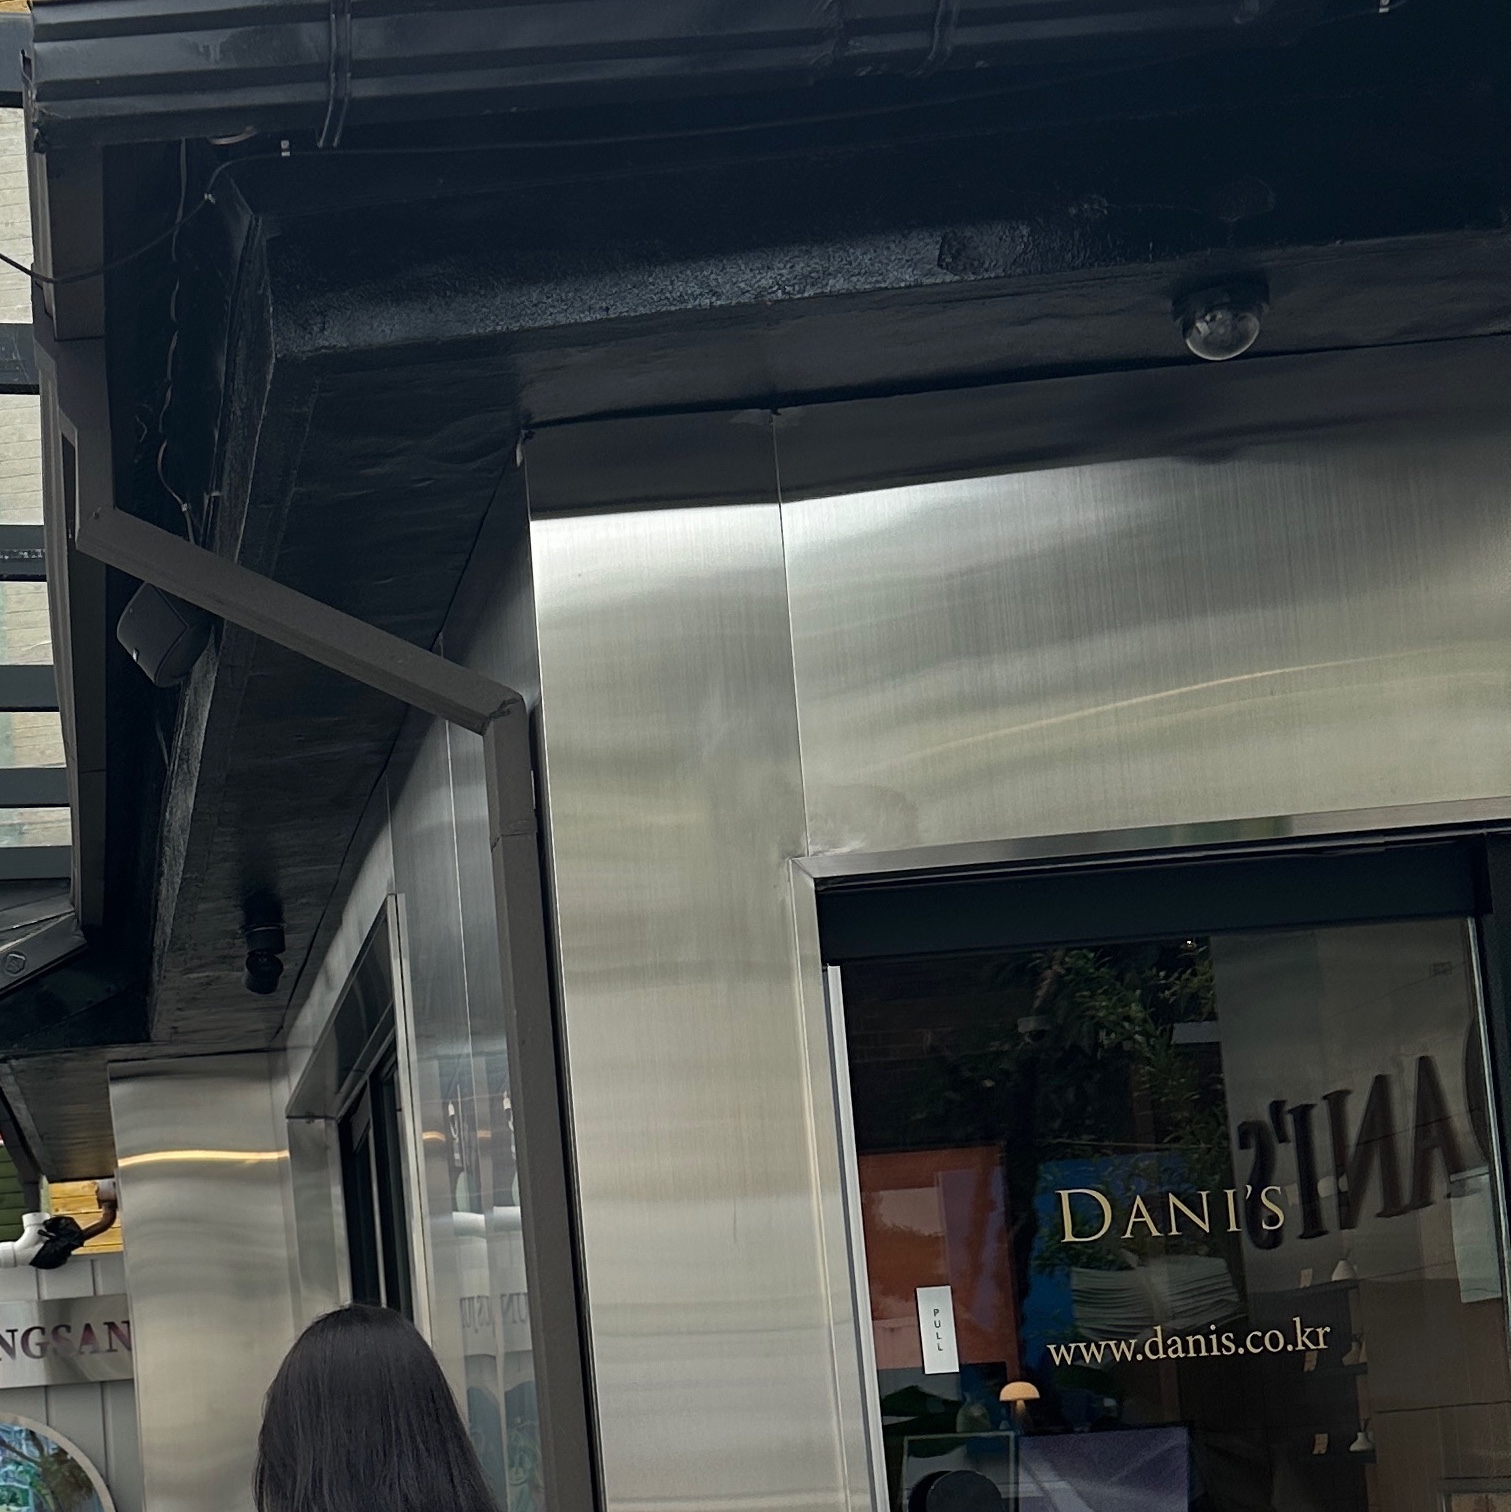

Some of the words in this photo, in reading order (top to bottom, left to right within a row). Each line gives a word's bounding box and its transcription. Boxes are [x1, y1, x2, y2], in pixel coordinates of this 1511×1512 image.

[1054, 1184, 1285, 1243] DANI'S
[933, 1308, 944, 1352] PULL
[1047, 1317, 1331, 1367] www.danis.co.kr
